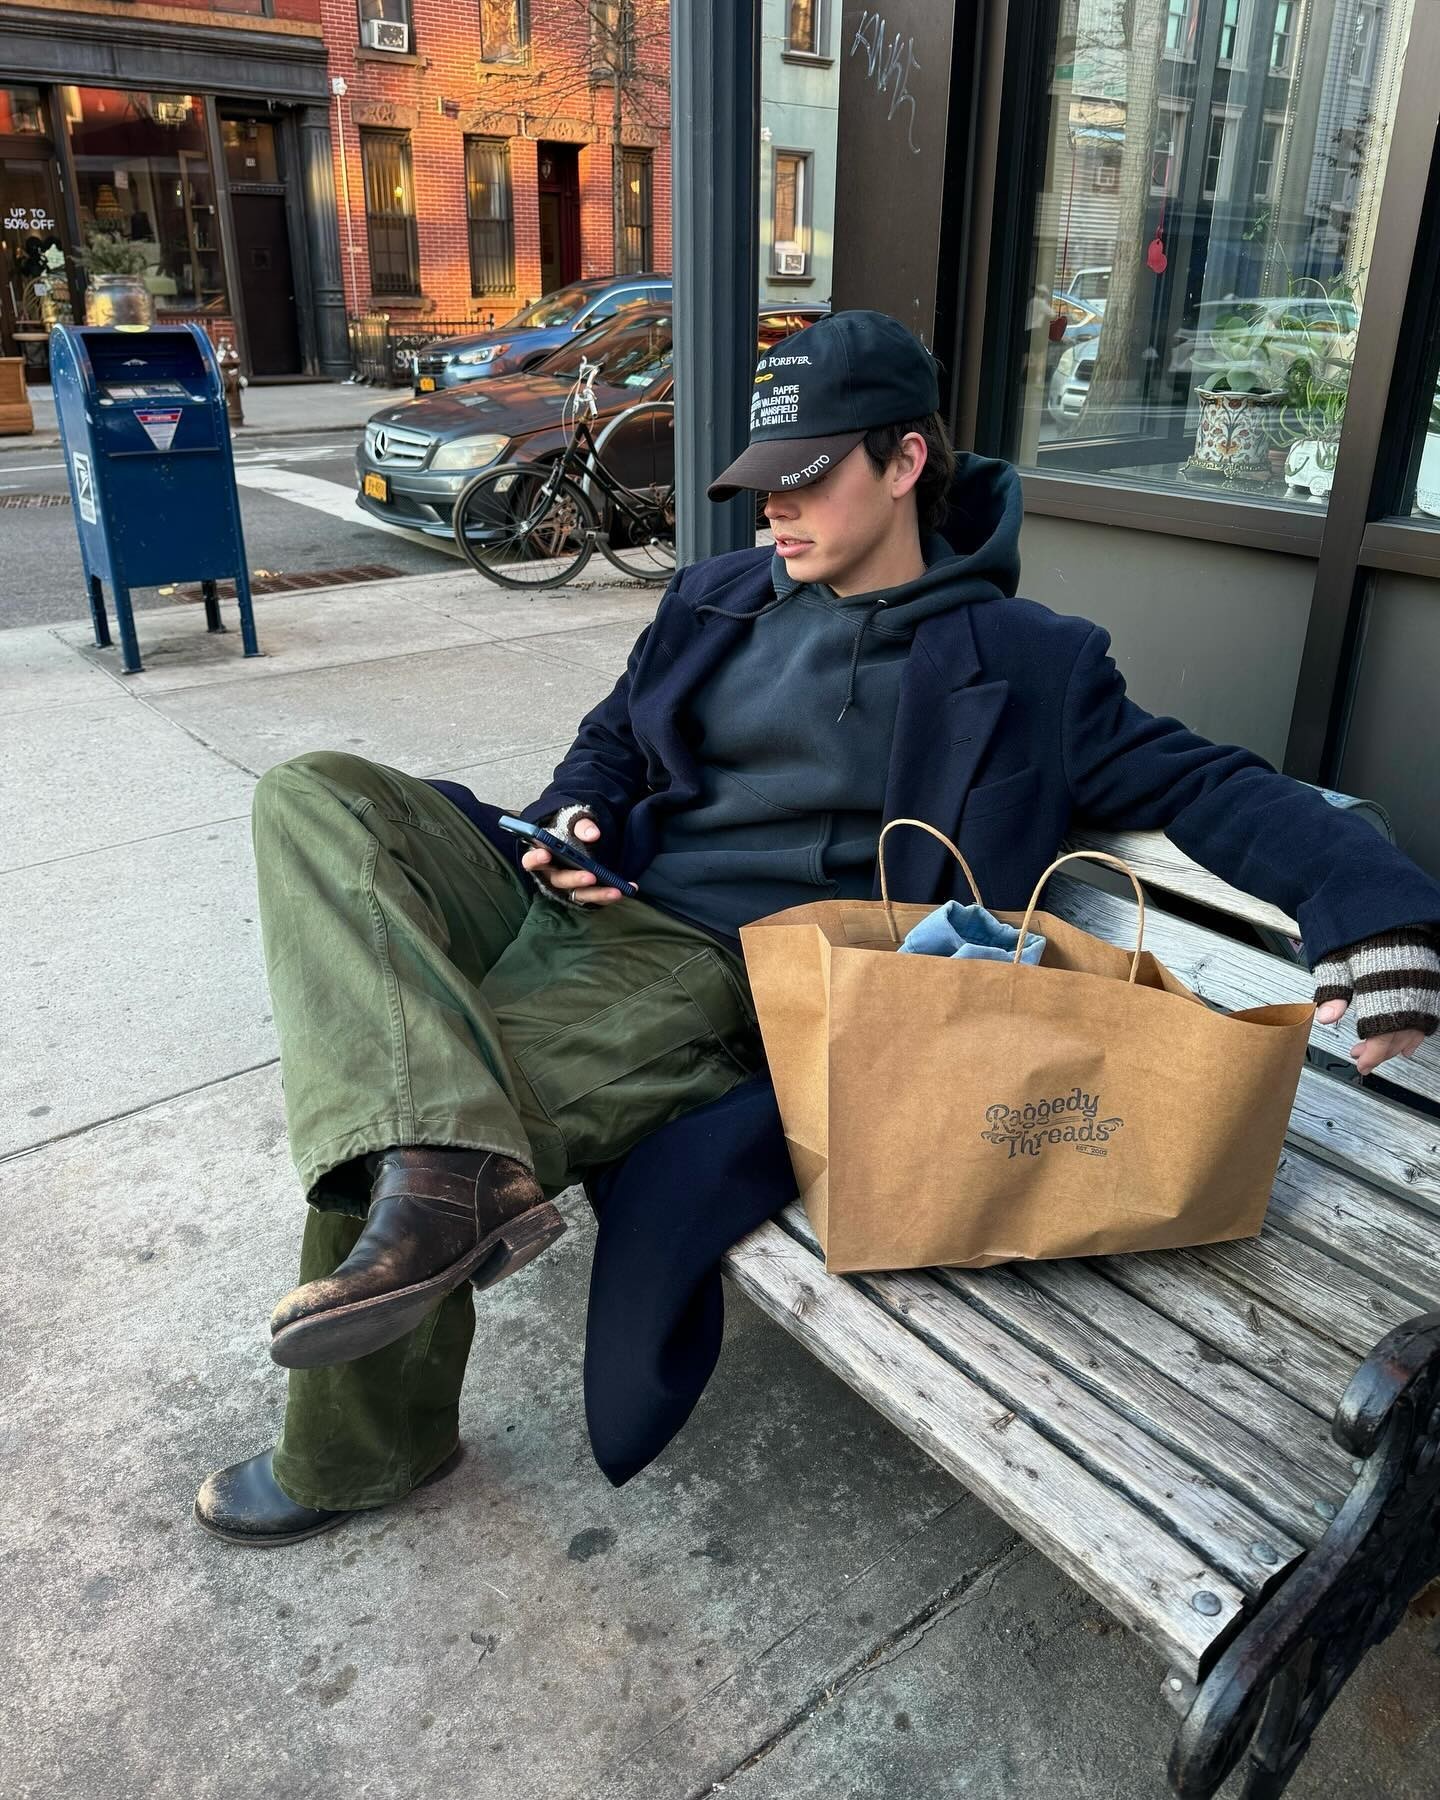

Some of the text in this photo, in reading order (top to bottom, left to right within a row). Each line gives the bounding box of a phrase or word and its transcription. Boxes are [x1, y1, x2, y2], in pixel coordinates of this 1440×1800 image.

[10, 208, 46, 219] UP TO
[4, 218, 55, 230] 50% OFF
[768, 356, 812, 368] FOREVER
[773, 385, 800, 396] RAPPE
[761, 394, 800, 408] VALENTINO
[760, 404, 799, 418] MANSFIELD
[762, 413, 798, 426] DEMILLE
[781, 455, 830, 485] RIP TOTO
[985, 1087, 1100, 1134] Raggedy
[981, 1117, 1124, 1159] Threads
